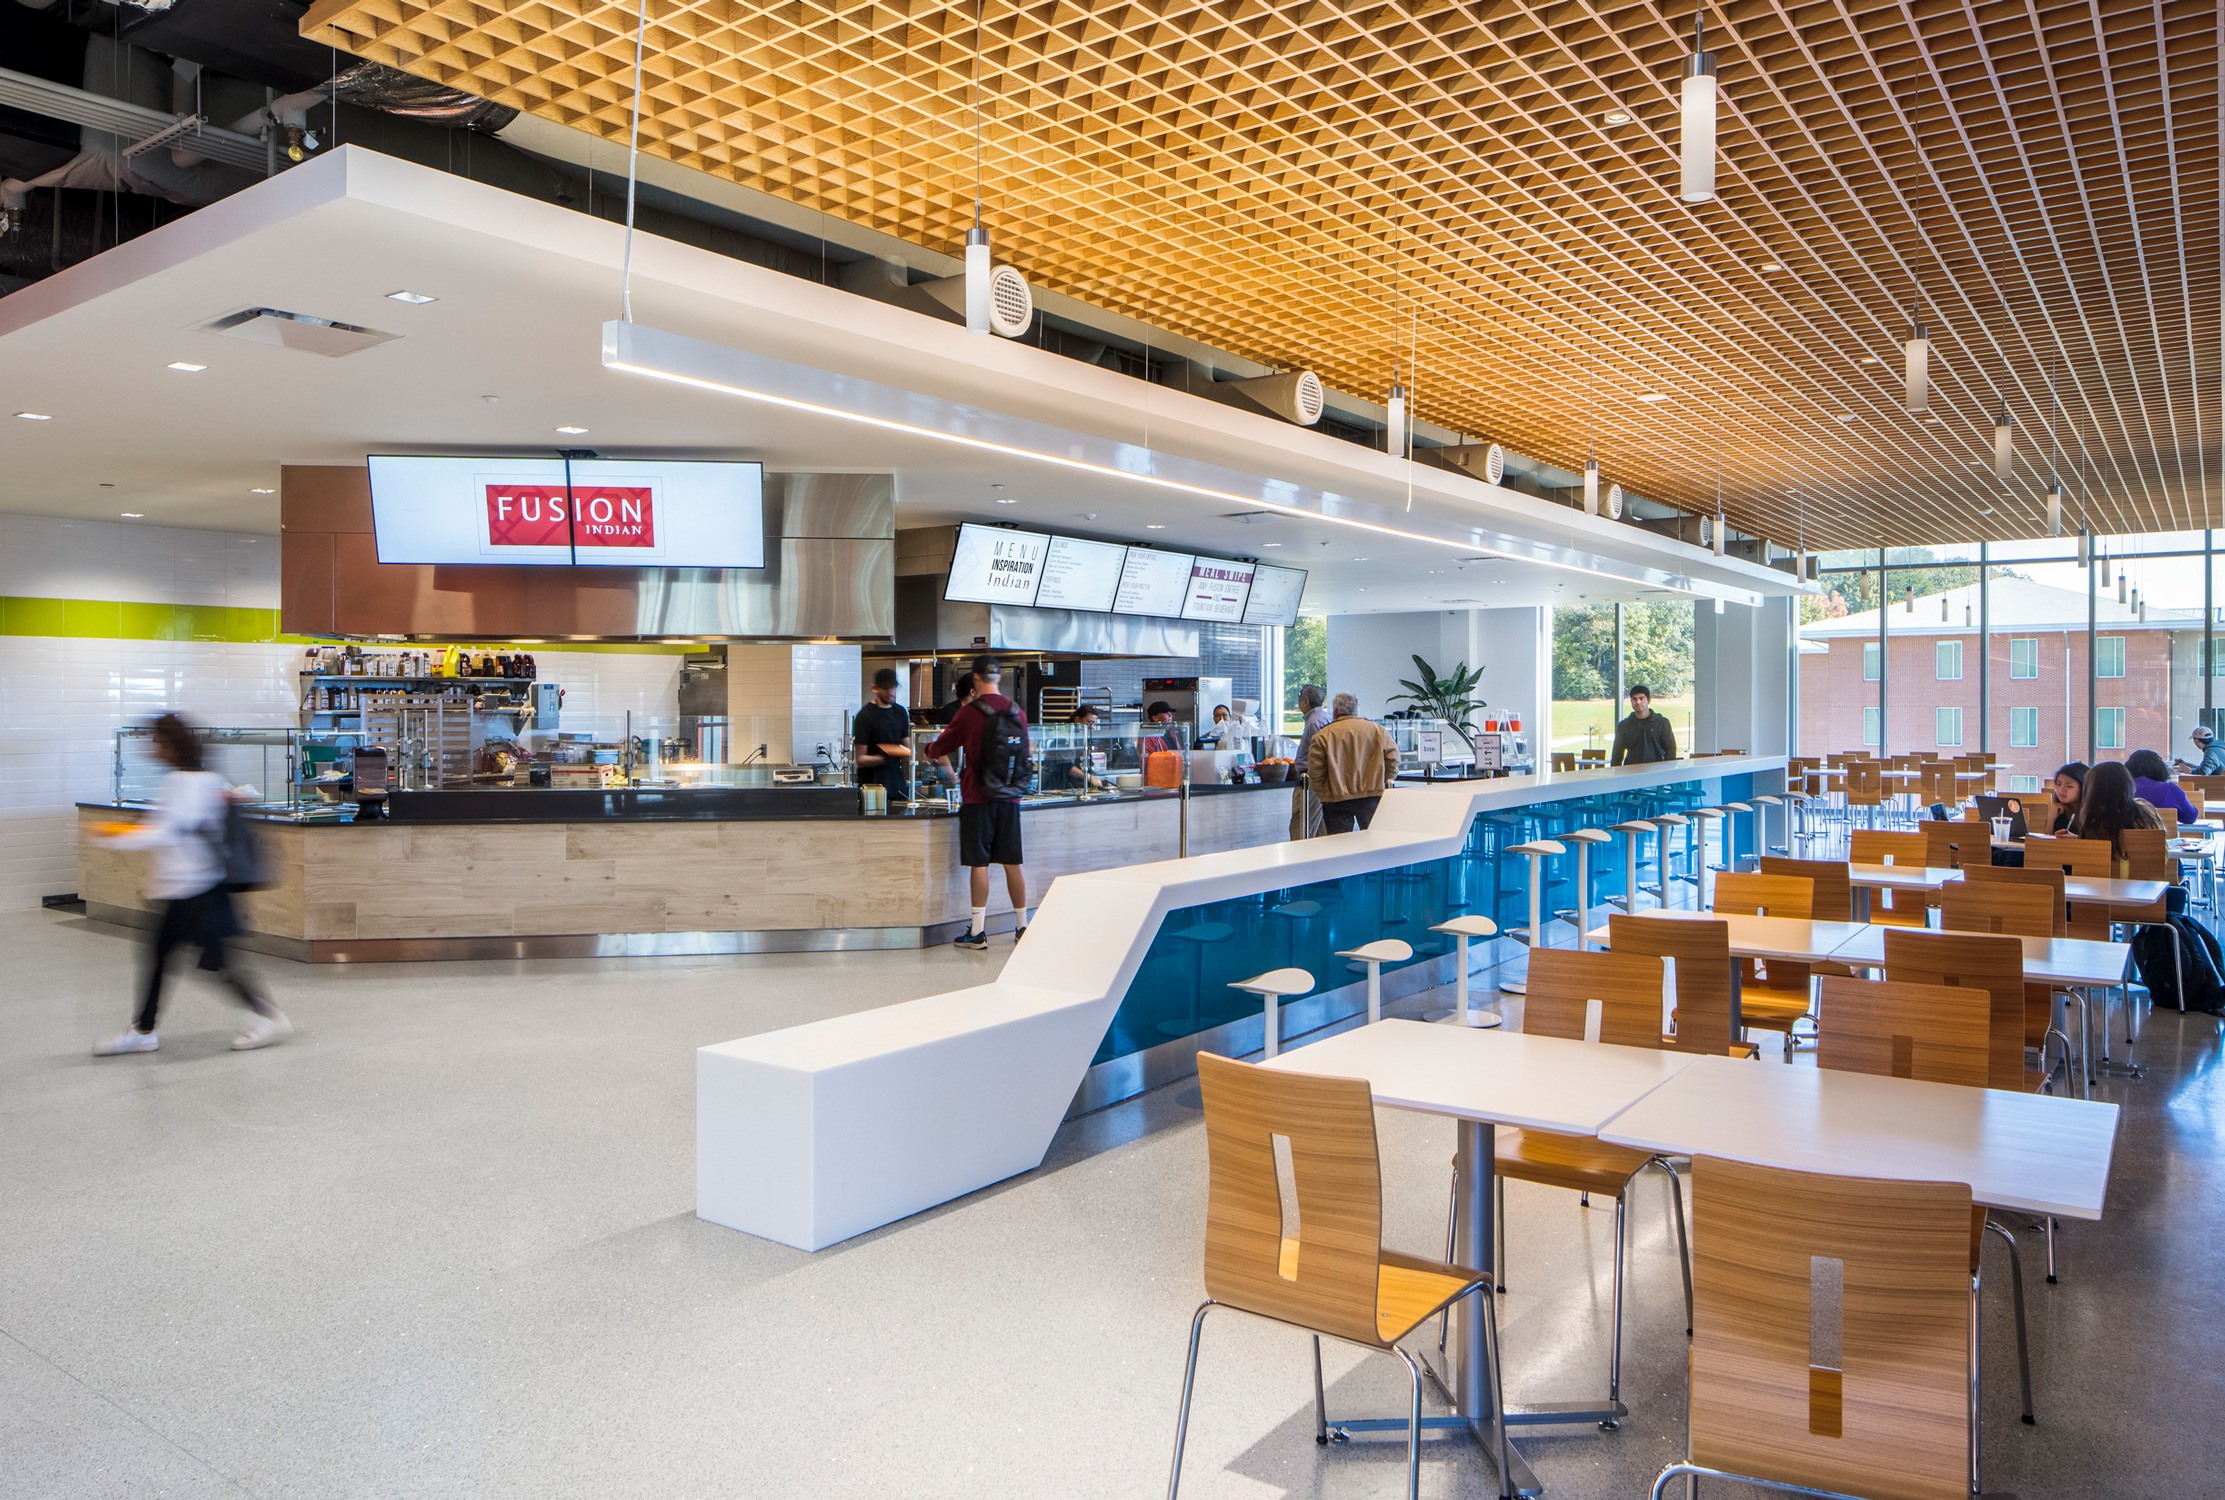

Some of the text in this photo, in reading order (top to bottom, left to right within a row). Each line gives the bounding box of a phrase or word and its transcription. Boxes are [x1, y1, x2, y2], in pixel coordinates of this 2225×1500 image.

[497, 496, 642, 523] FUSION
[585, 525, 643, 536] INDIAN
[993, 541, 1039, 561] MENU
[991, 558, 1035, 574] INSPIRATION
[987, 572, 1030, 589] Indian
[1199, 567, 1219, 578] MEAL
[1223, 570, 1247, 582] SWIPE
